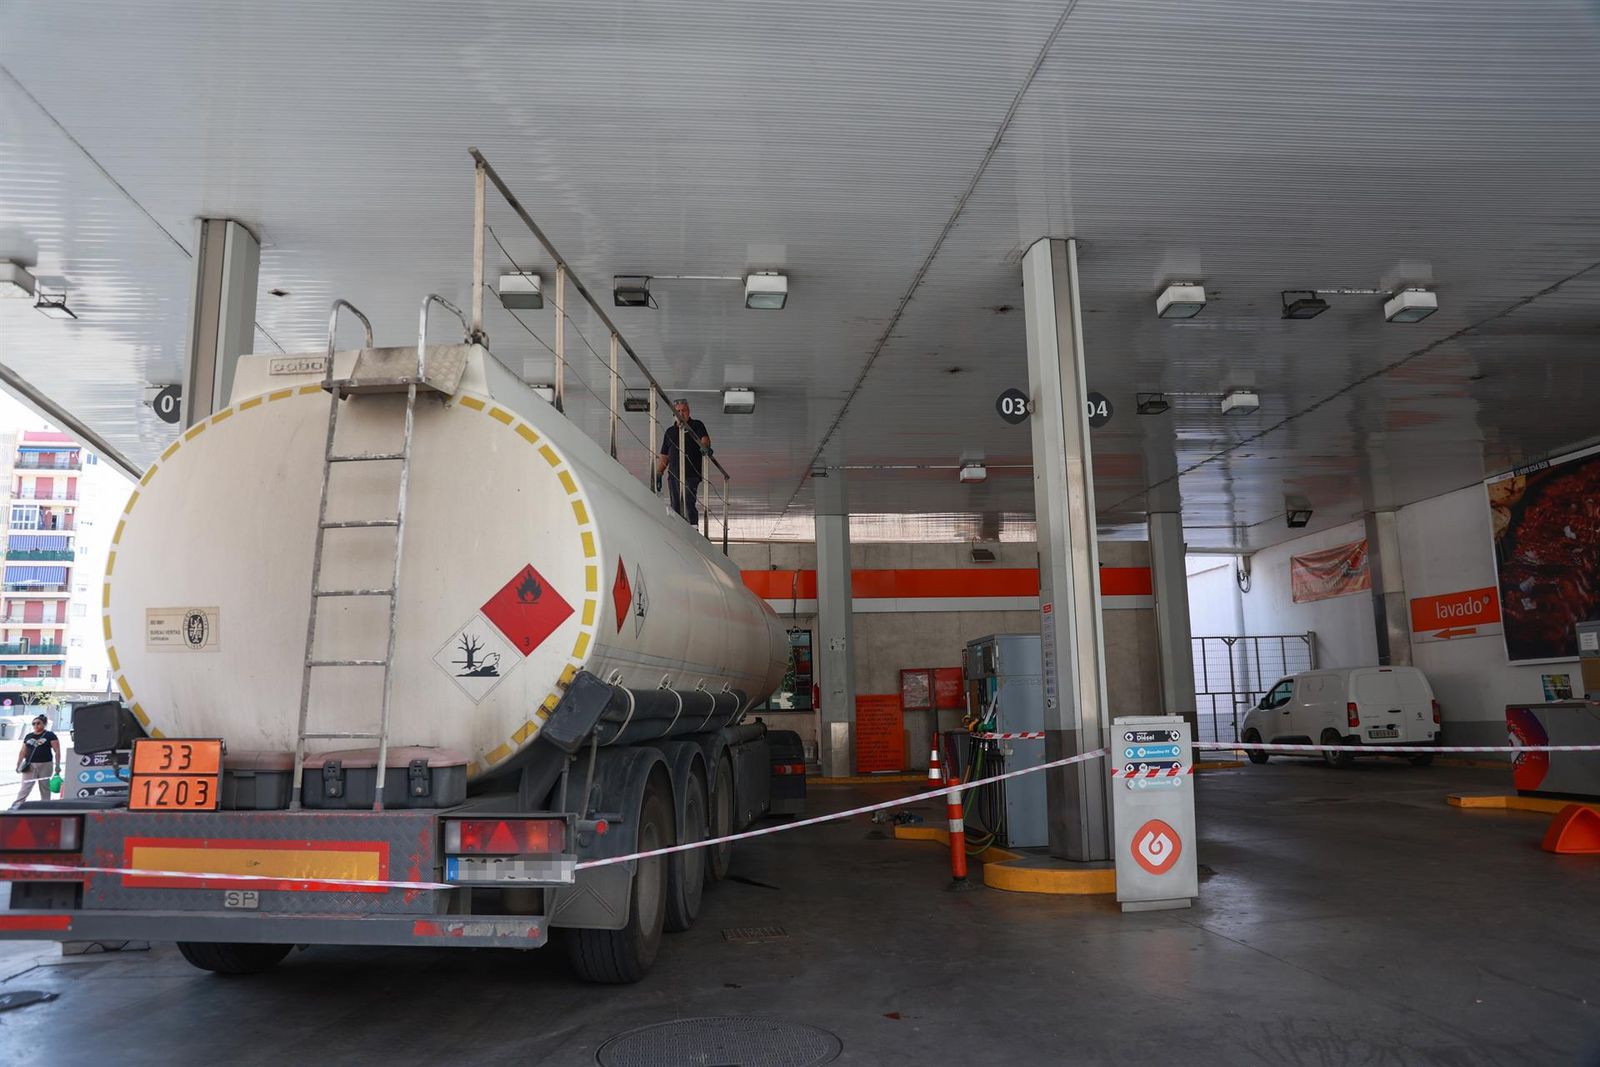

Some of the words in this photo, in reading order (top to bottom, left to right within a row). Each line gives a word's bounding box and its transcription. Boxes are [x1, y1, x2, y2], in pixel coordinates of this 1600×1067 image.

[161, 395, 181, 413] 0
[1001, 397, 1026, 415] 03
[1087, 400, 1108, 418] 04
[1435, 596, 1482, 619] lavado
[523, 637, 530, 647] 3
[160, 744, 192, 770] 33
[143, 780, 209, 806] 1203
[227, 892, 256, 906] SP
